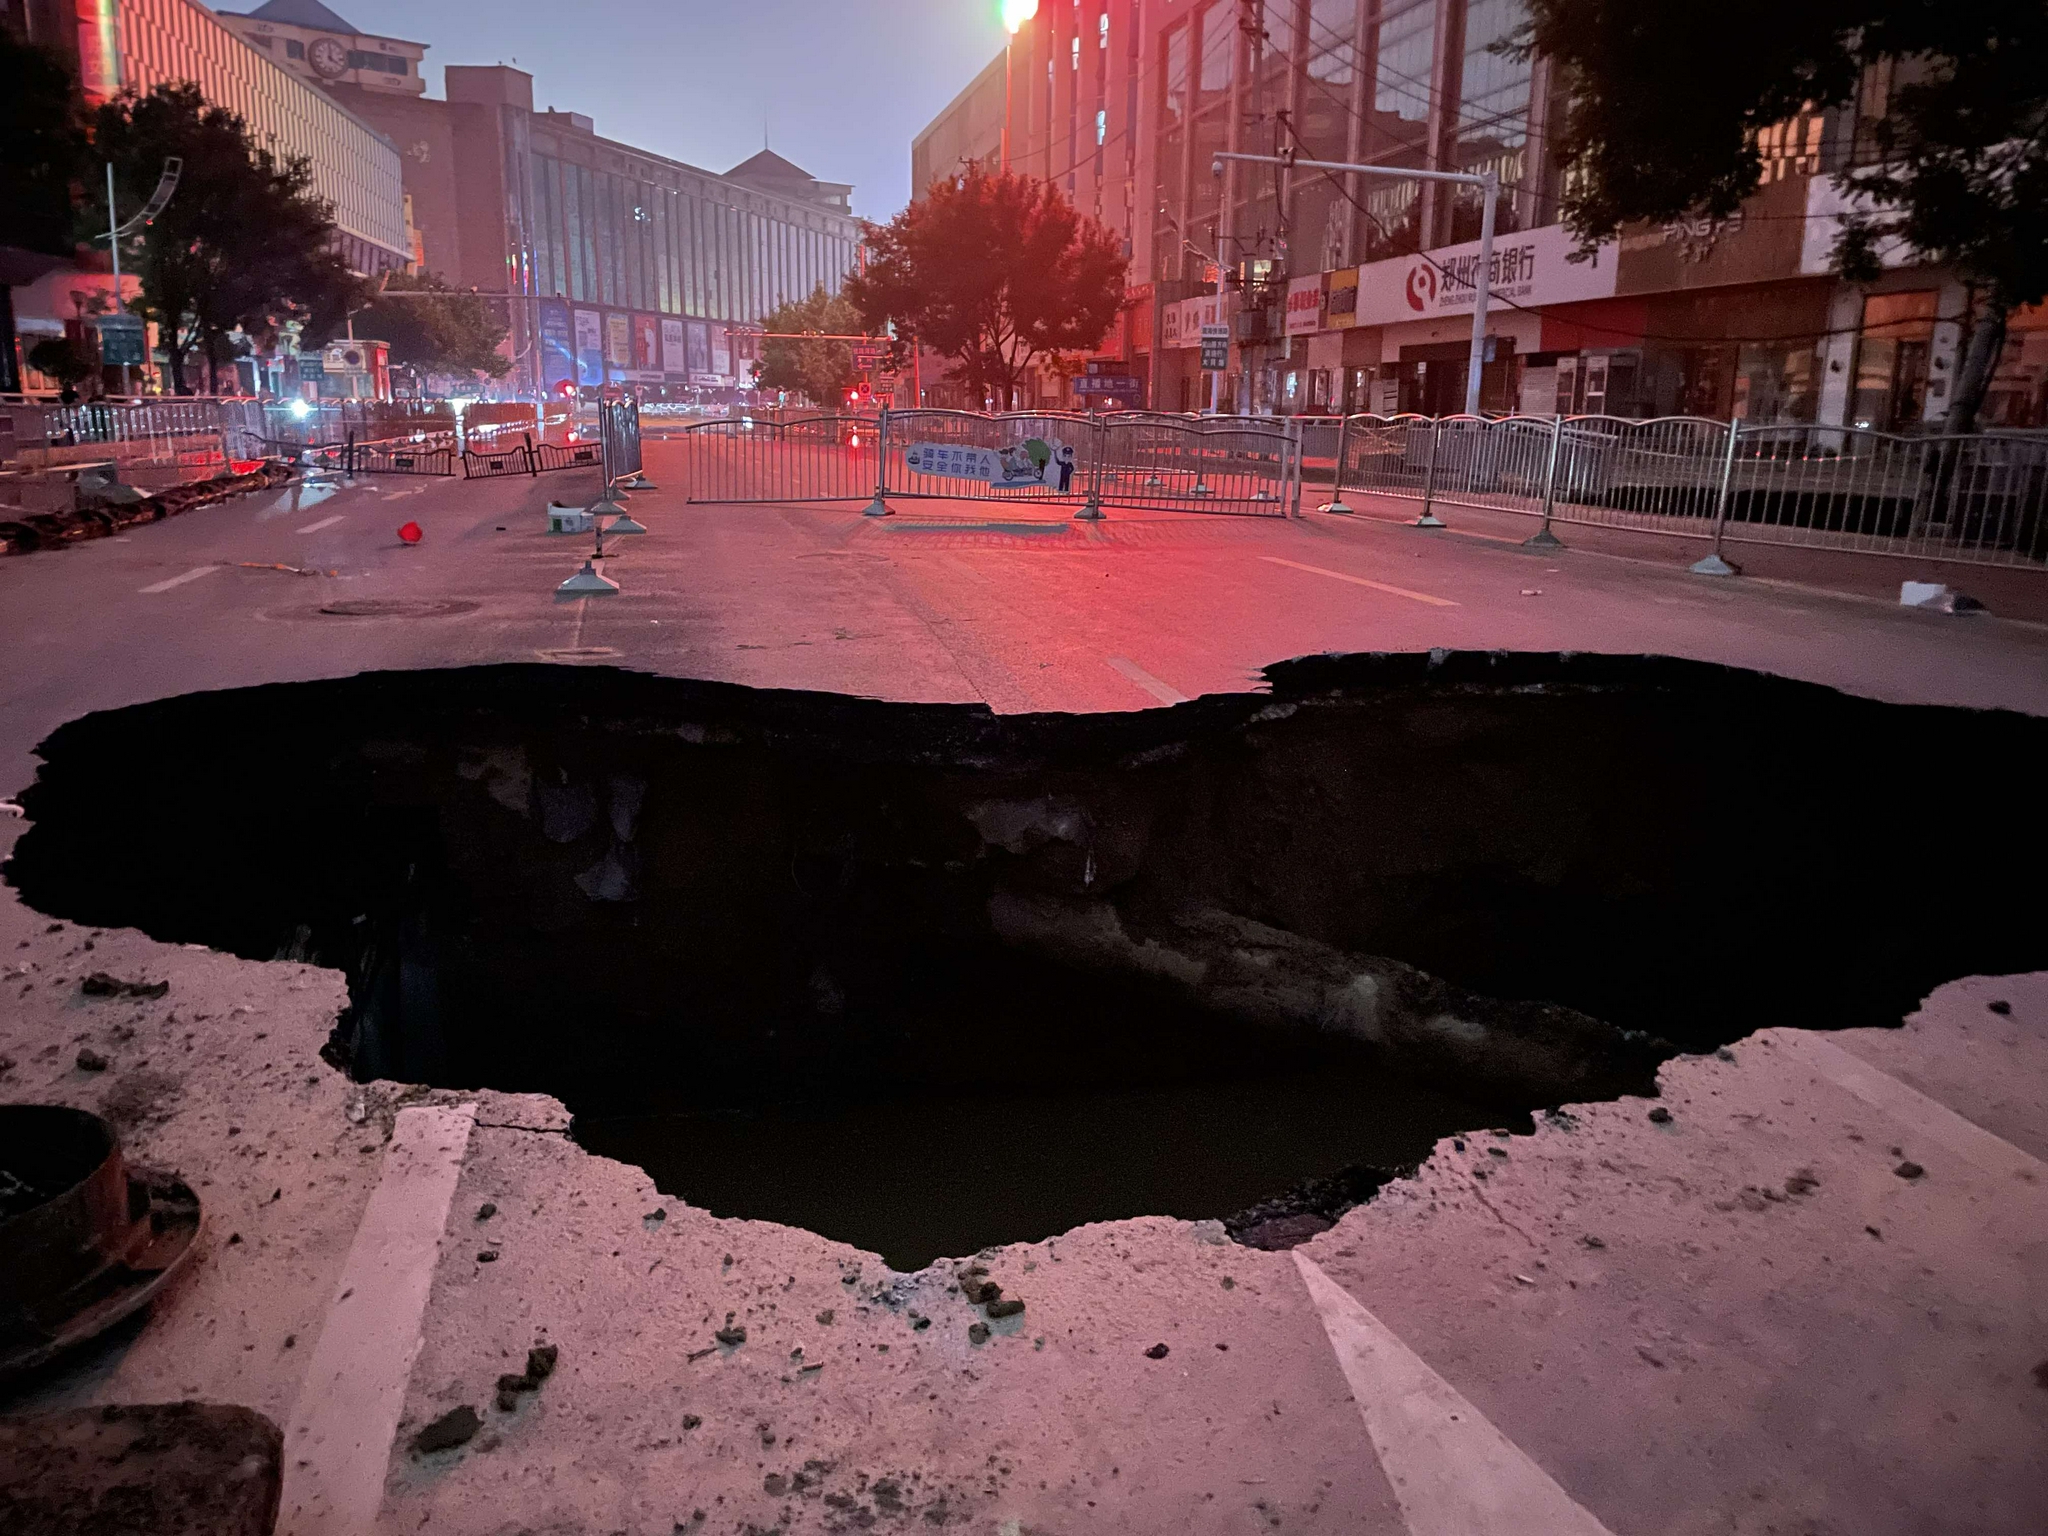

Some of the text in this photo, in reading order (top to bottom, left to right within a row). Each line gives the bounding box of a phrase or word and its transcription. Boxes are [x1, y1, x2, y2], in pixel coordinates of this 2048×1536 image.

[923, 447, 991, 465] 骑车不带人
[922, 459, 990, 477] 安全你我他
